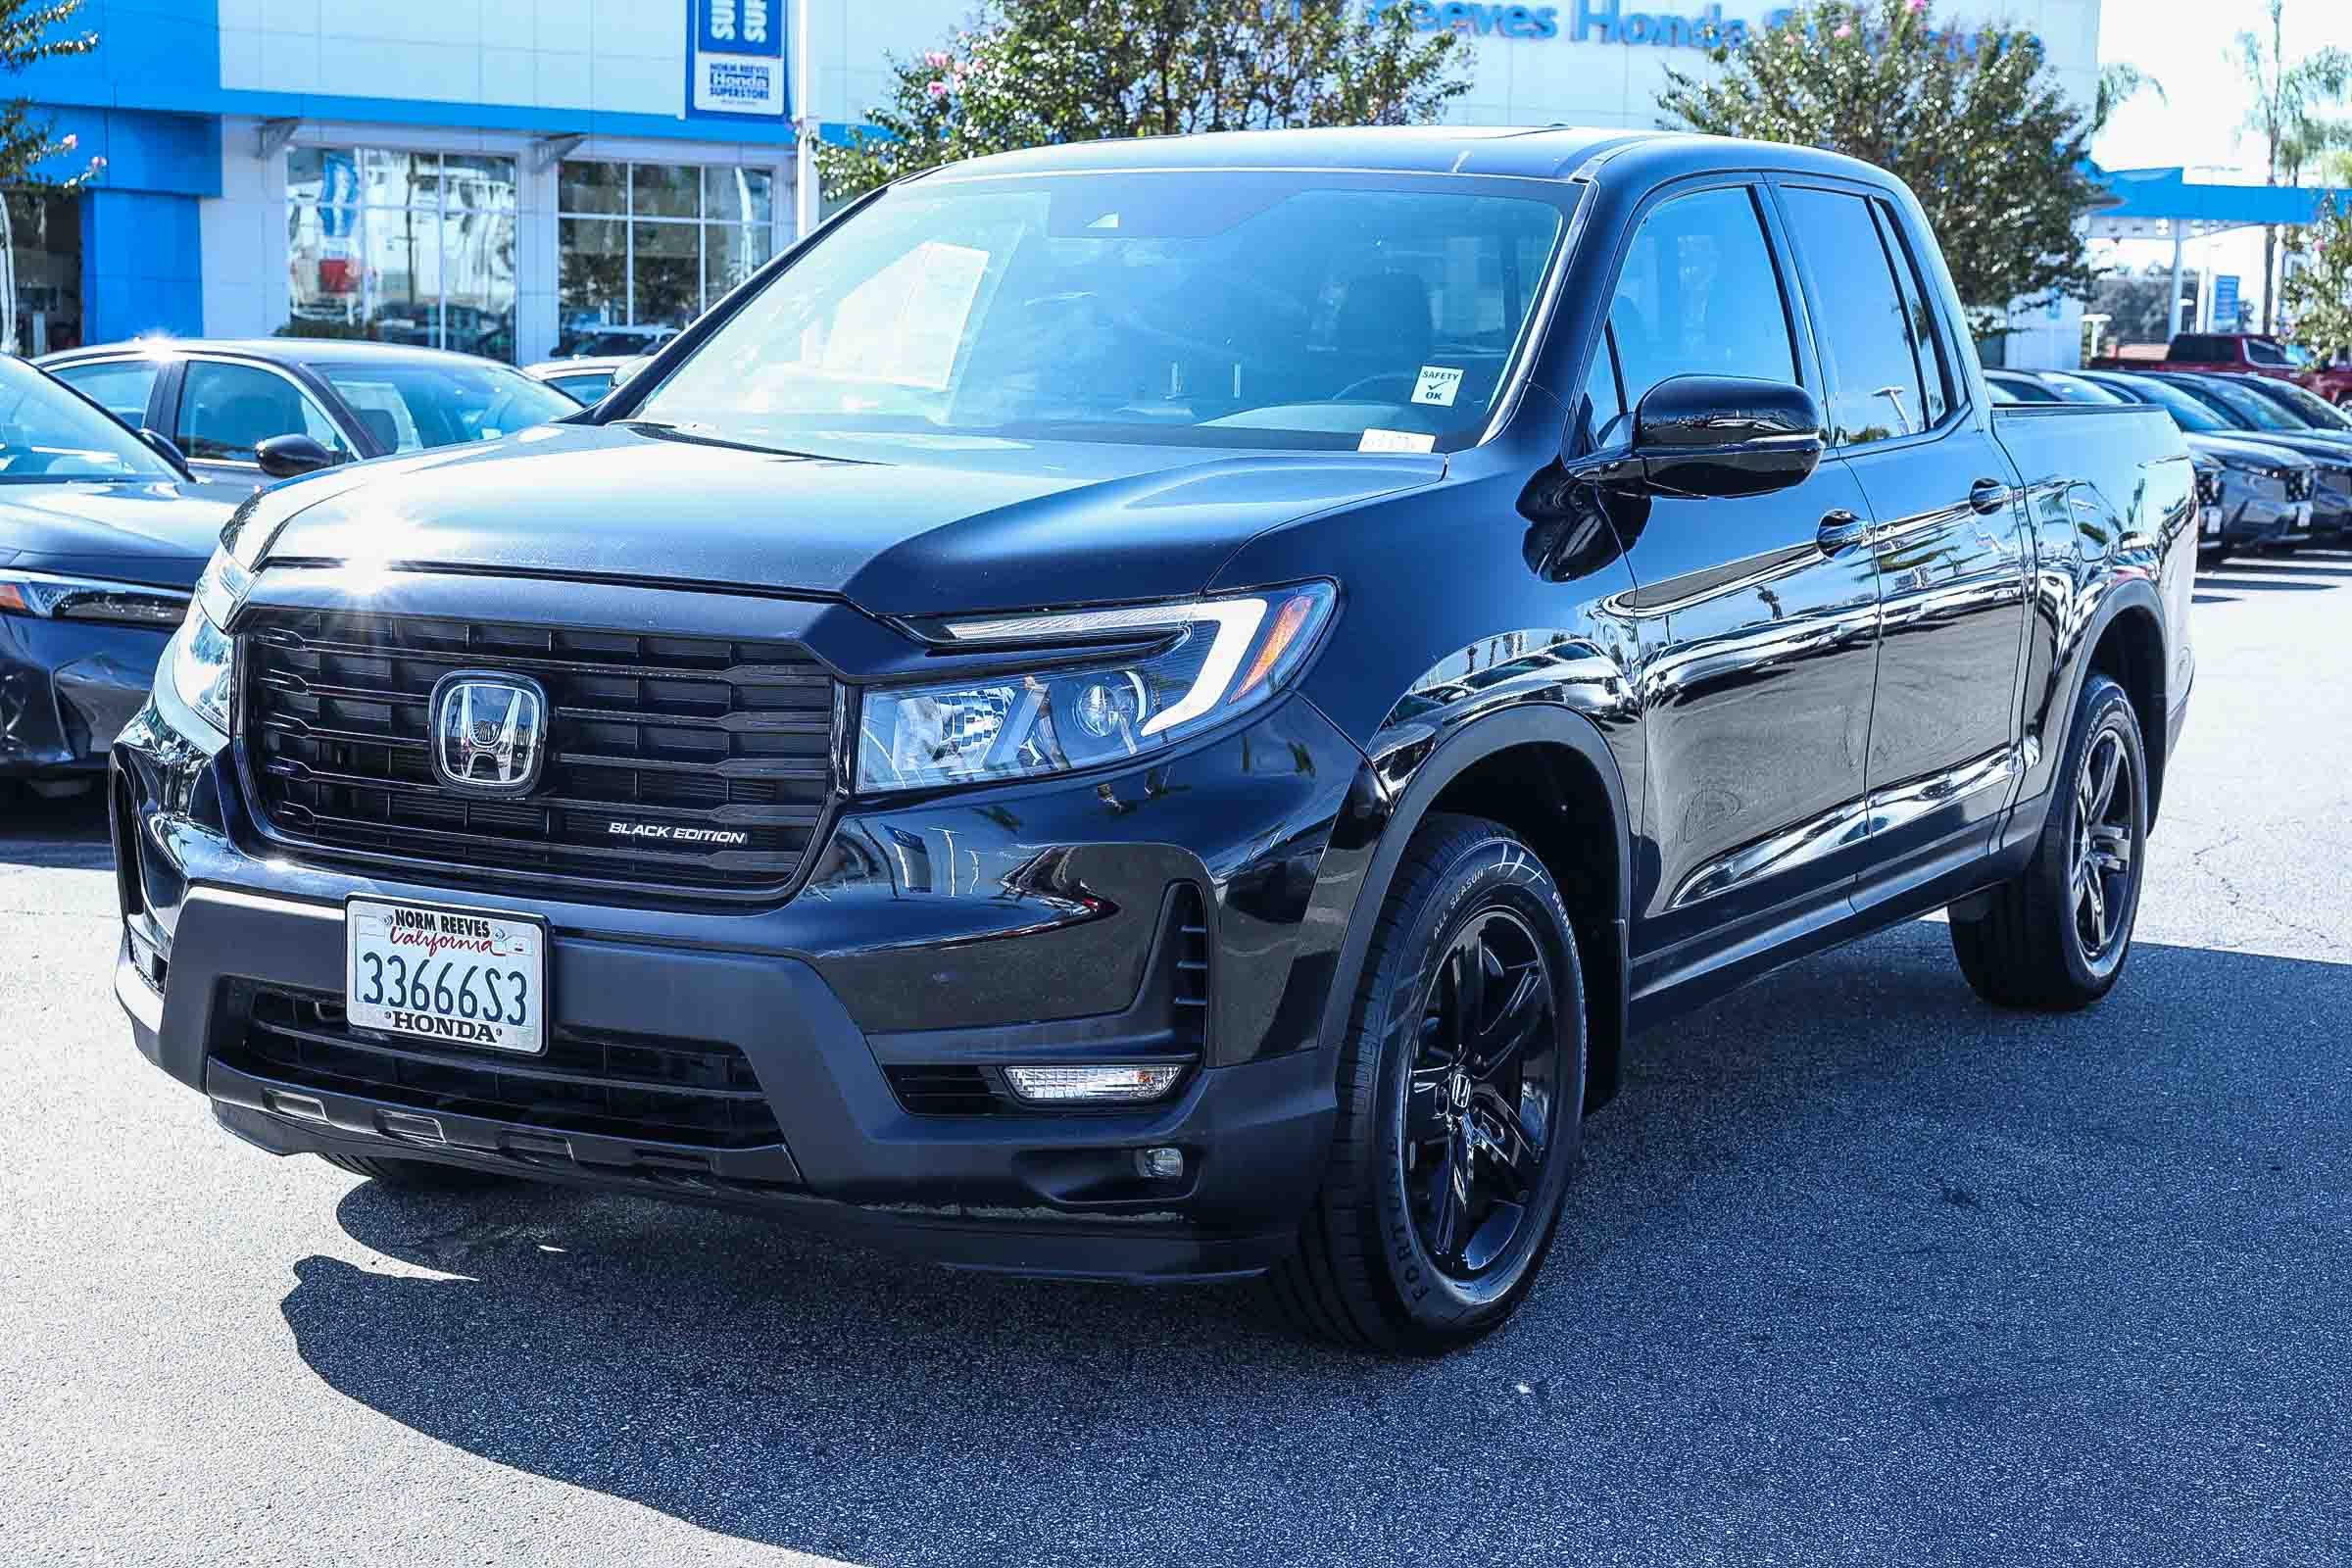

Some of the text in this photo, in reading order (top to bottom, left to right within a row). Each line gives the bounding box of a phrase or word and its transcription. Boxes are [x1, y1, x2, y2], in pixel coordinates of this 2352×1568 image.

[1571, 0, 1747, 48] Honda
[711, 73, 768, 88] Honda
[1422, 370, 1459, 381] SAFETY
[1425, 391, 1443, 400] OK
[609, 822, 745, 844] BLACK EDITION
[1434, 868, 1485, 940] ALL SEASON
[395, 908, 490, 938] NORM REEVES
[390, 925, 506, 957] California
[363, 952, 527, 1026] 33666S3
[392, 1010, 498, 1043] HONDA
